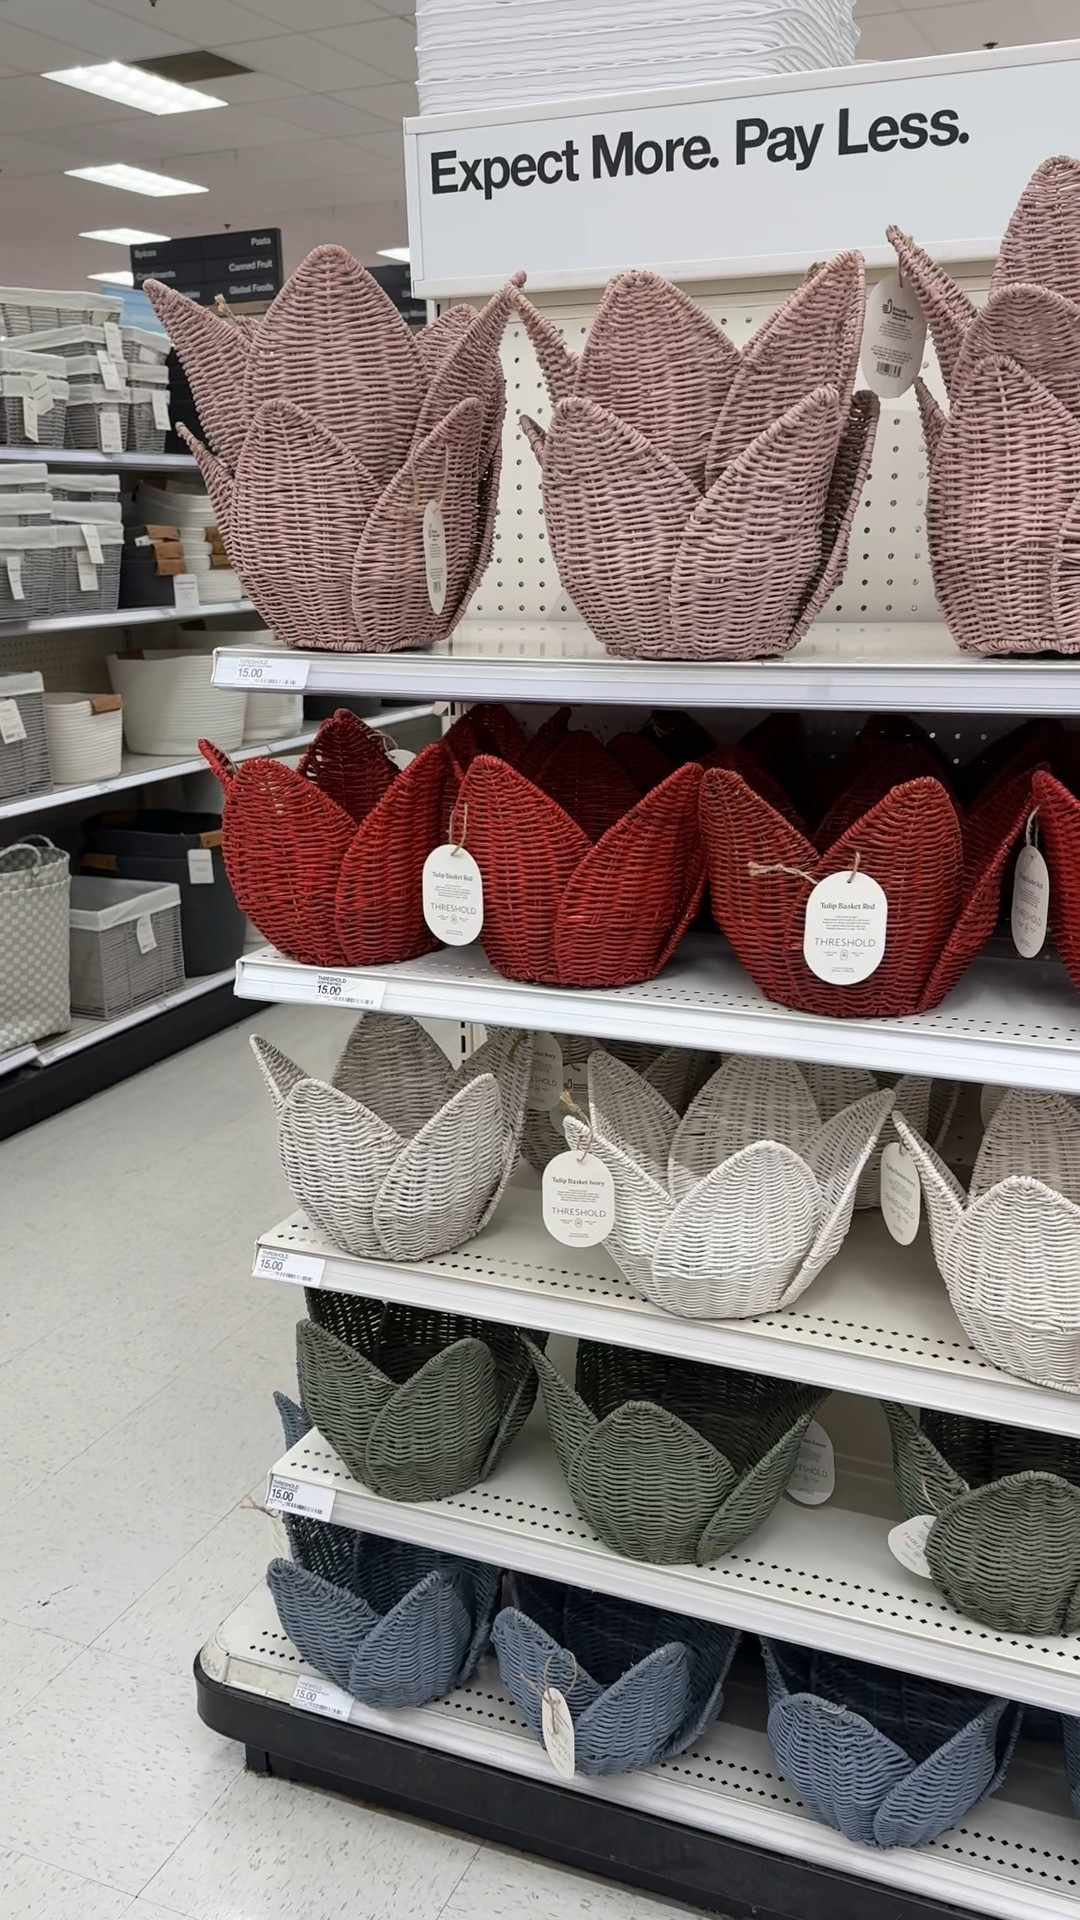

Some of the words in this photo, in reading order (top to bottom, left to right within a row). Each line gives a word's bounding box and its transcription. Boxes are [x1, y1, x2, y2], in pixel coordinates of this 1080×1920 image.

[430, 140, 580, 200] Expect
[592, 131, 720, 179] More.
[735, 118, 825, 171] Pay
[837, 107, 970, 156] Less.
[250, 237, 272, 247] Pasta
[228, 261, 256, 273] Canned
[256, 259, 274, 270] Fruit
[228, 284, 252, 296] Global
[252, 282, 275, 293] Foods
[238, 668, 263, 678] 15.00
[432, 871, 446, 880] Tulip
[430, 902, 477, 916] THRESHOLD
[820, 902, 838, 911] Tulip
[838, 902, 862, 910] Basket
[814, 937, 876, 948] THRESHOLD
[317, 975, 347, 985] THRESHOLD
[316, 985, 342, 996] 15.00
[552, 1176, 568, 1185] Tulip
[568, 1178, 589, 1186] Basket
[589, 1180, 605, 1188] Ivory
[551, 1206, 607, 1218] THRESHOLD
[262, 1251, 289, 1259] THRESHOLD
[260, 1259, 284, 1271] 15.00
[273, 1480, 299, 1489] THRESHOLD
[272, 1489, 294, 1501] 15.00
[296, 1689, 317, 1701] 15.00
